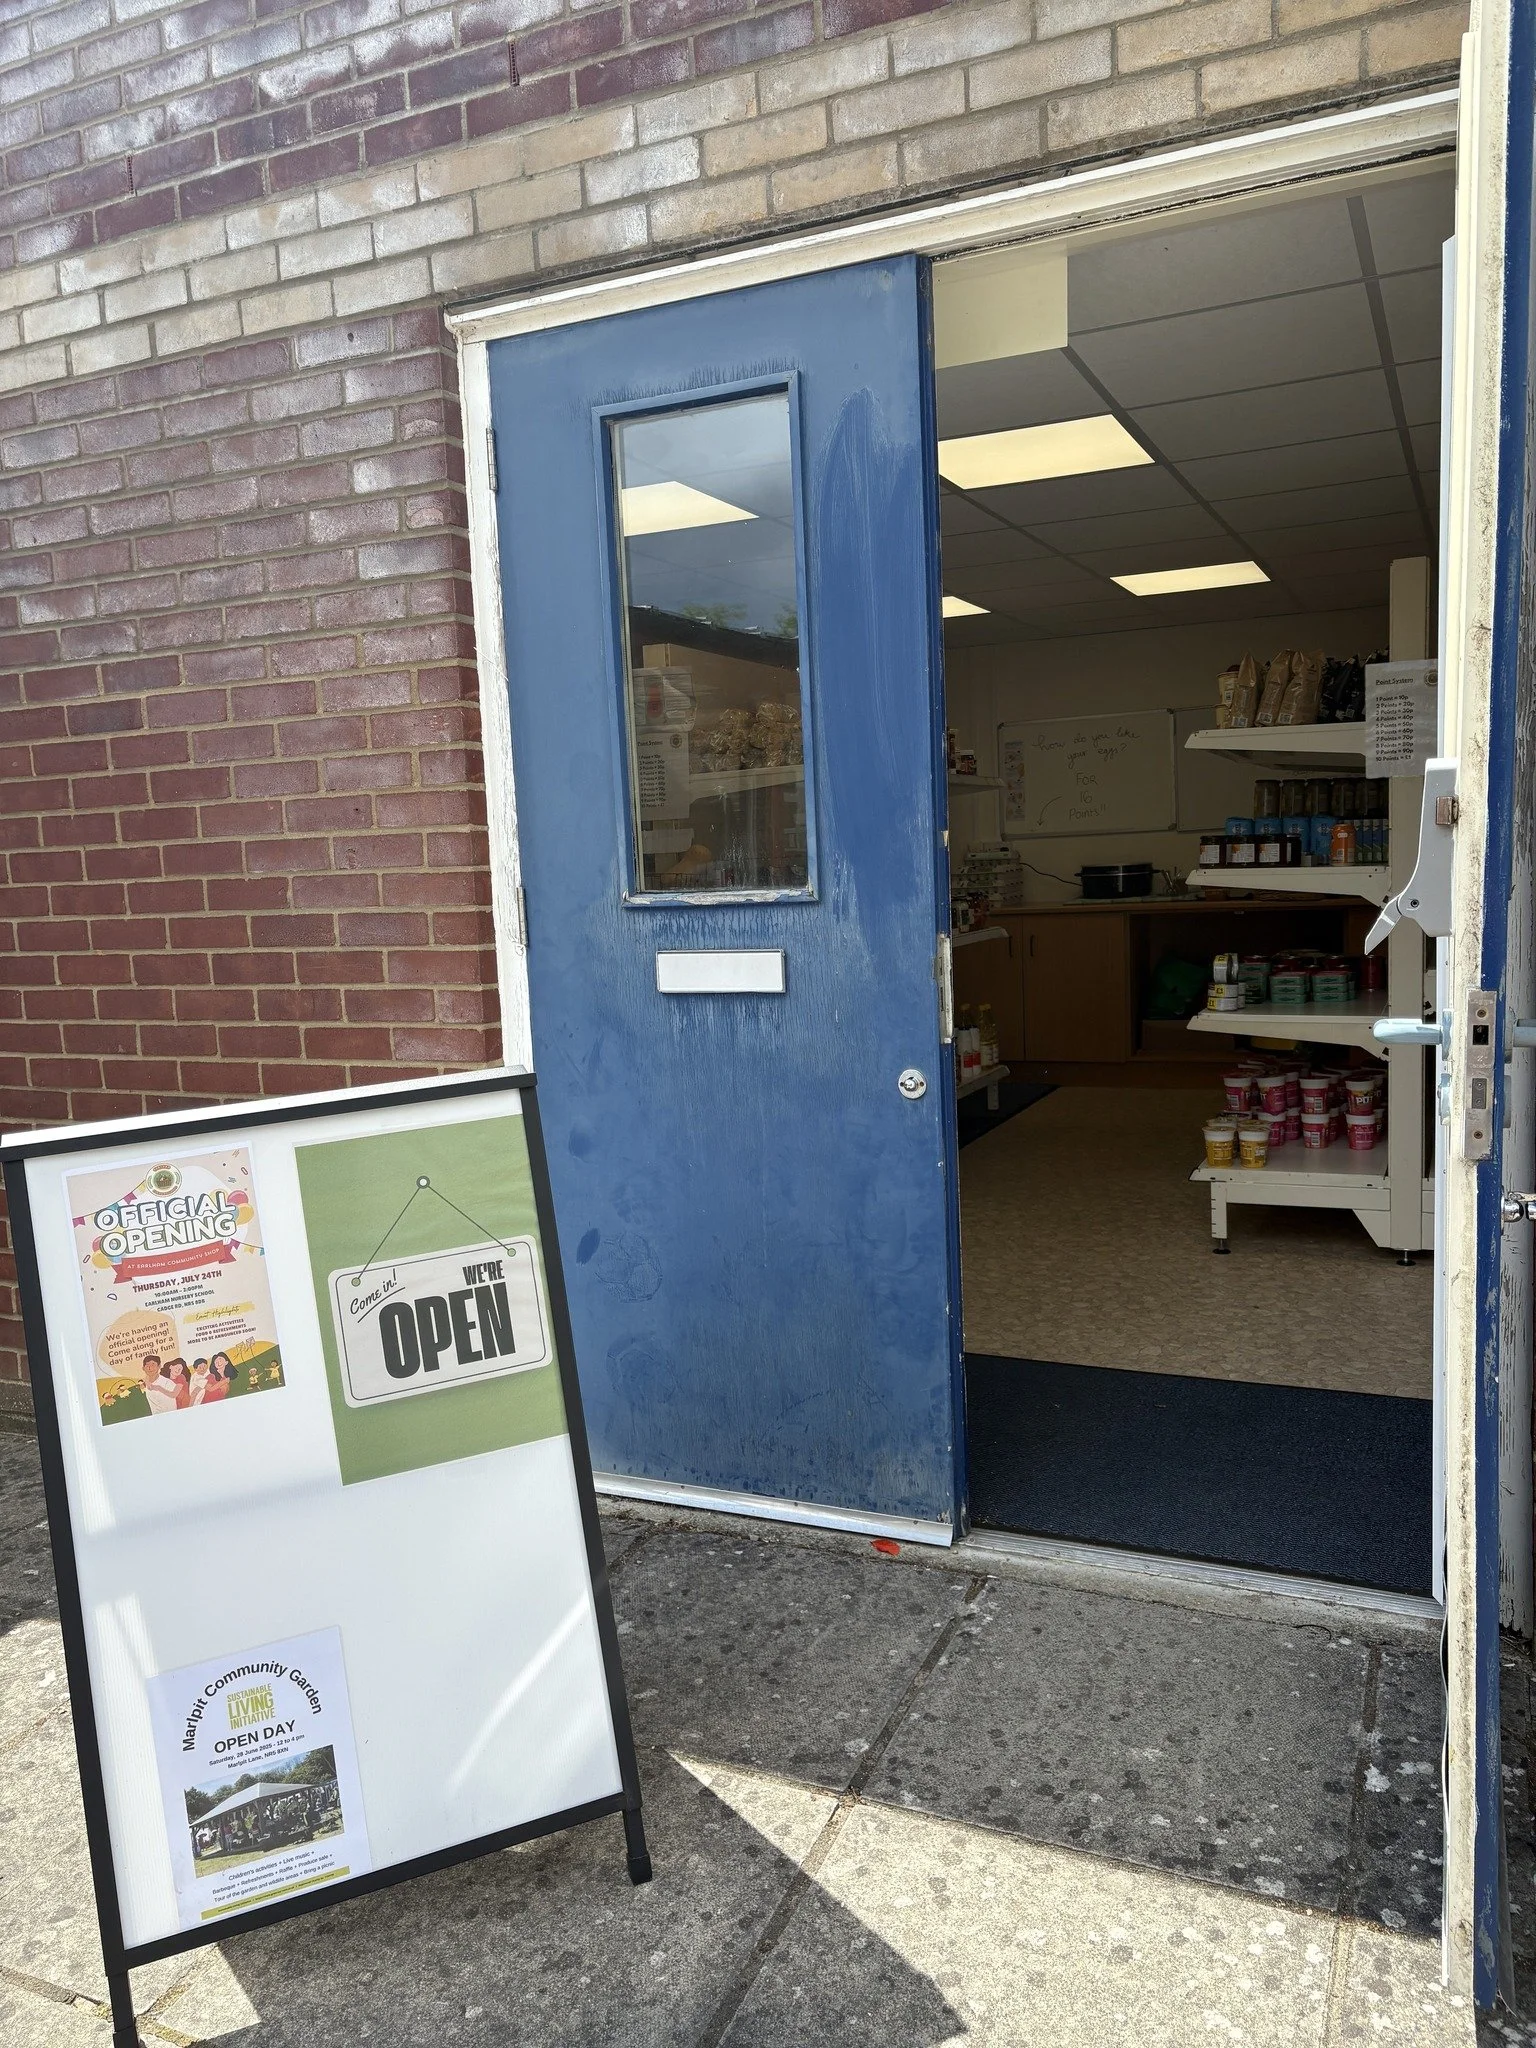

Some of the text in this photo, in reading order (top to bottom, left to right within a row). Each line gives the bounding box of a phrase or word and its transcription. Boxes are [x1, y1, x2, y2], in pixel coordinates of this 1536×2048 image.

[1032, 727, 1140, 751] how do you like
[1067, 744, 1127, 769] your eggs?
[1080, 790, 1093, 804] 16
[94, 1191, 237, 1231] OFFICIAL
[100, 1213, 237, 1257] OPENING
[137, 1260, 165, 1271] EARLHAM
[167, 1254, 202, 1265] COMMUNITY
[205, 1248, 220, 1257] SHOP
[133, 1270, 221, 1293] THURSDAY, JULY 24TH
[462, 1260, 505, 1285] WE'RE
[145, 1299, 170, 1307] EARLHAM
[171, 1294, 194, 1302] NURSERY
[350, 1268, 398, 1315] Come in!
[106, 1331, 129, 1341] We're
[132, 1324, 157, 1335] having
[109, 1329, 169, 1349] official opening!
[379, 1282, 516, 1379] OPEN
[108, 1347, 130, 1357] Come
[133, 1342, 154, 1351] along
[136, 1348, 159, 1358] family
[161, 1343, 175, 1351] fun!
[227, 1683, 272, 1702] SUSTAINABLE
[182, 1661, 322, 1752] Marlpit Community Garden
[228, 1692, 274, 1719] LIVING
[230, 1707, 275, 1729] INITIATIVE
[214, 1719, 296, 1754] OPEN DAY
[209, 1754, 235, 1765] Saturday,
[249, 1755, 263, 1763] Lane,
[229, 1869, 254, 1880] Children's
[256, 1862, 277, 1872] activities
[295, 1852, 310, 1860] music
[241, 1872, 274, 1885] Refreshments
[299, 1858, 317, 1867] Produce
[241, 1886, 257, 1894] garden
[269, 1877, 284, 1885] wildlife
[322, 1861, 335, 1869] picnic
